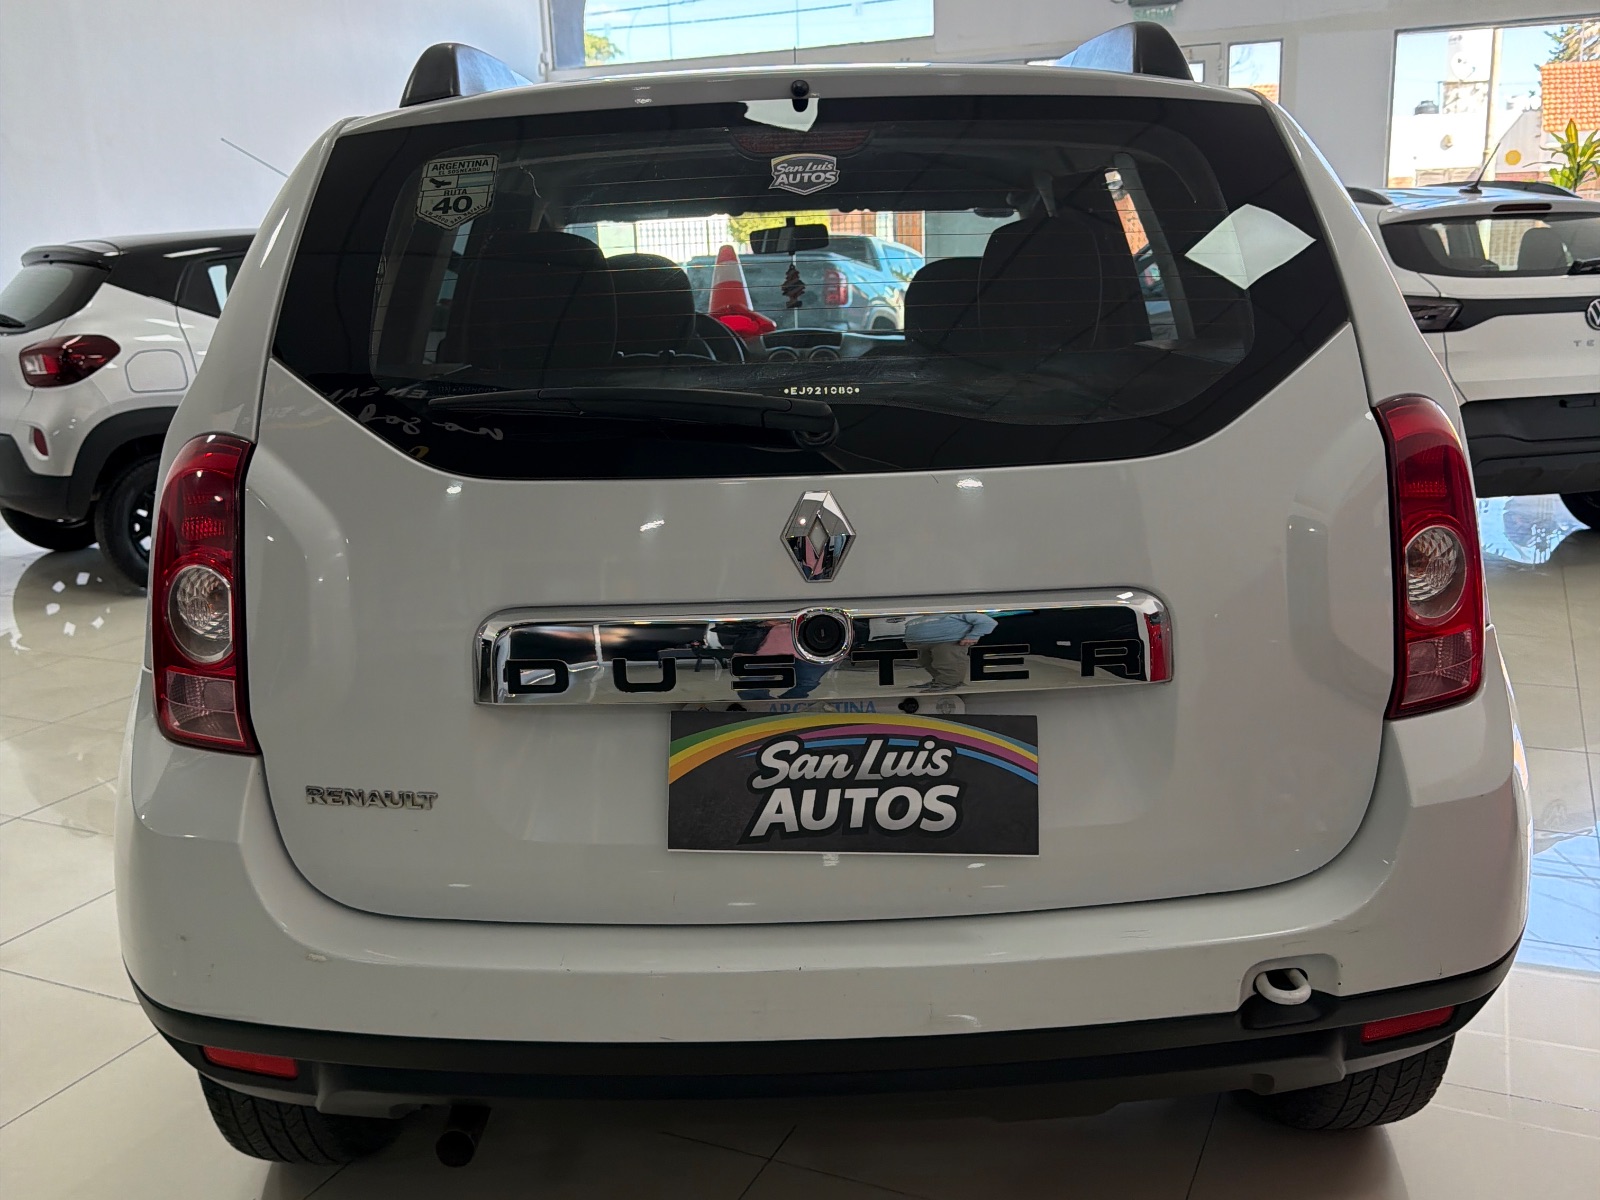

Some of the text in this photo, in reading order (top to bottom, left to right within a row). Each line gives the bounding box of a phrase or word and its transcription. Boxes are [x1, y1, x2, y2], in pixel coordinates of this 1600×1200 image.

[432, 159, 489, 171] ARGENTINA
[775, 162, 834, 175] San Luis
[774, 172, 836, 186] AUTOS
[432, 196, 473, 214] 40
[503, 639, 1142, 694] DUSTER
[769, 700, 878, 713] ARGTINA
[752, 739, 952, 789] San Luis
[305, 785, 438, 810] RENAULT
[749, 785, 960, 838] AUTOS
